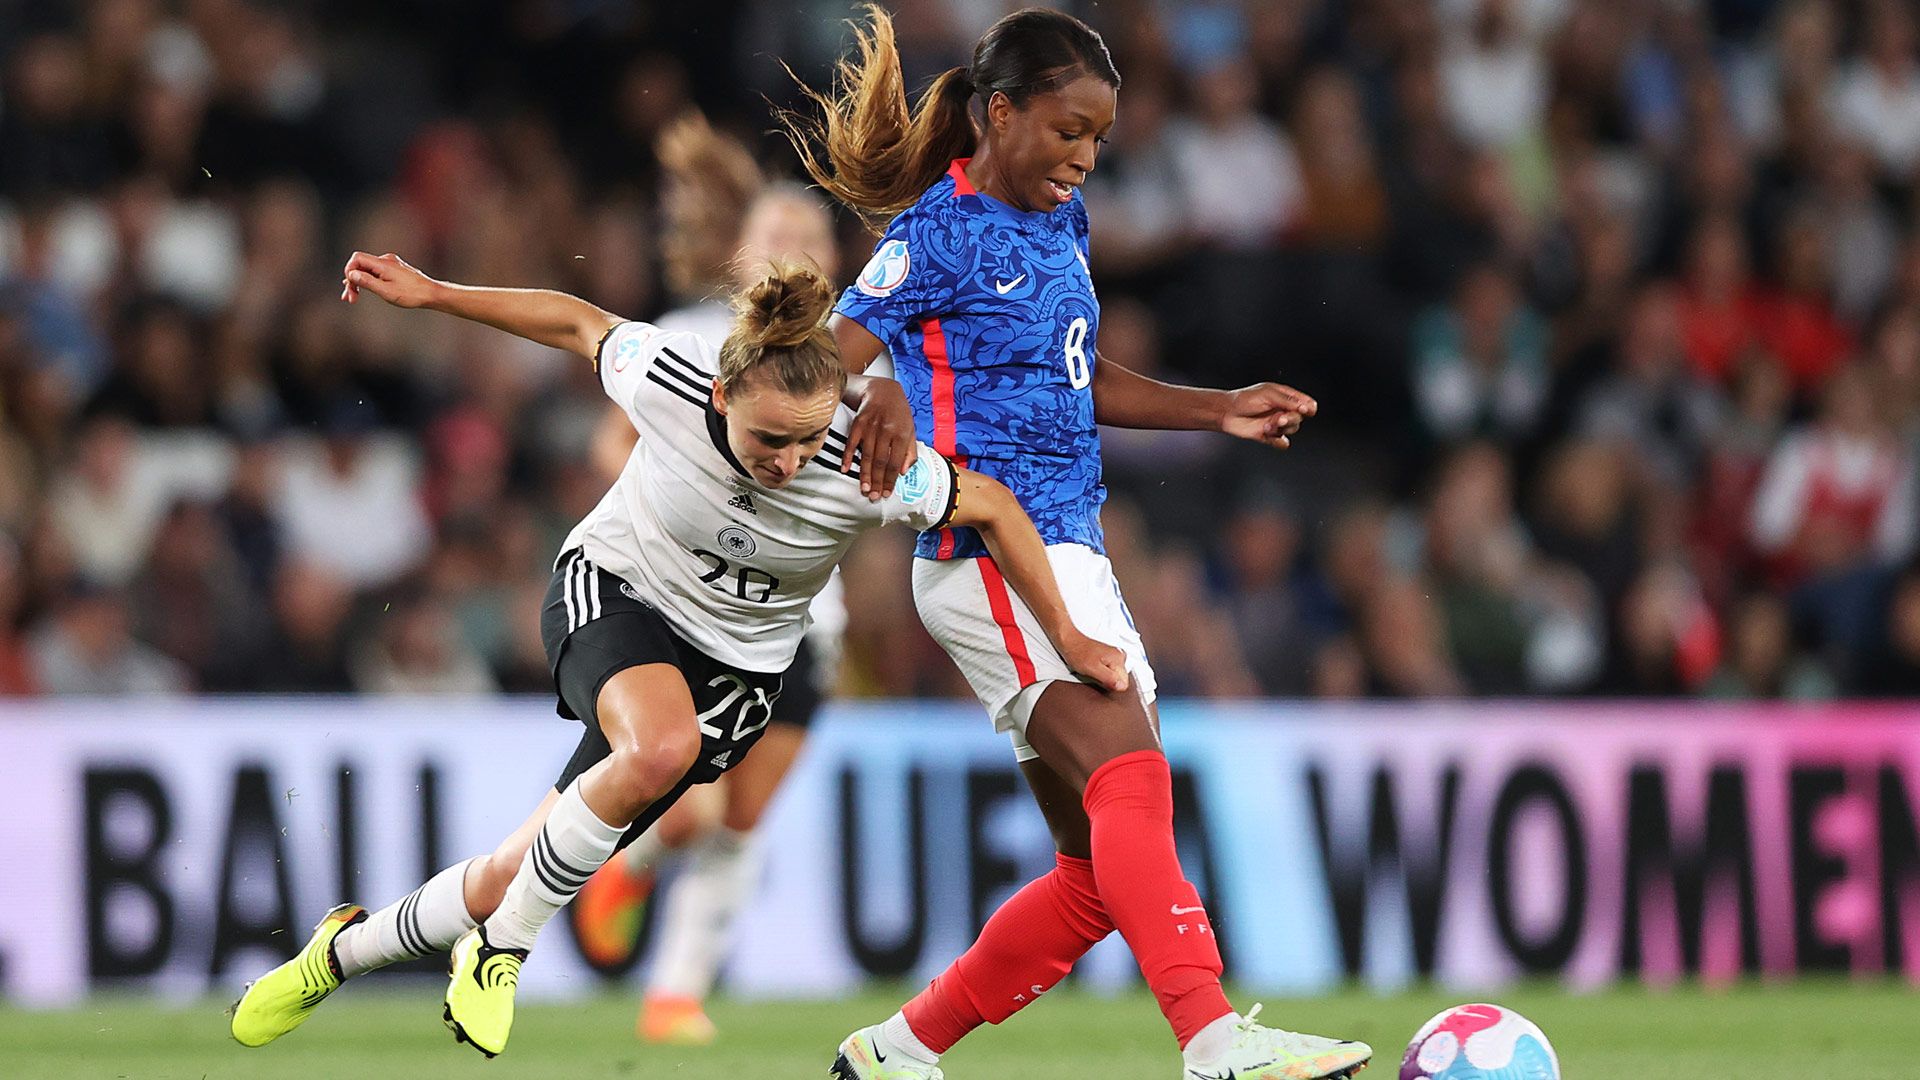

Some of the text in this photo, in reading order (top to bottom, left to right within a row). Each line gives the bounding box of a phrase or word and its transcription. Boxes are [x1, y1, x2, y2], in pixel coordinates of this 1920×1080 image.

[1064, 317, 1091, 391] 8
[727, 499, 758, 516] adidas
[692, 548, 780, 604] 20
[696, 673, 773, 742] 20
[836, 760, 1234, 984] UEA
